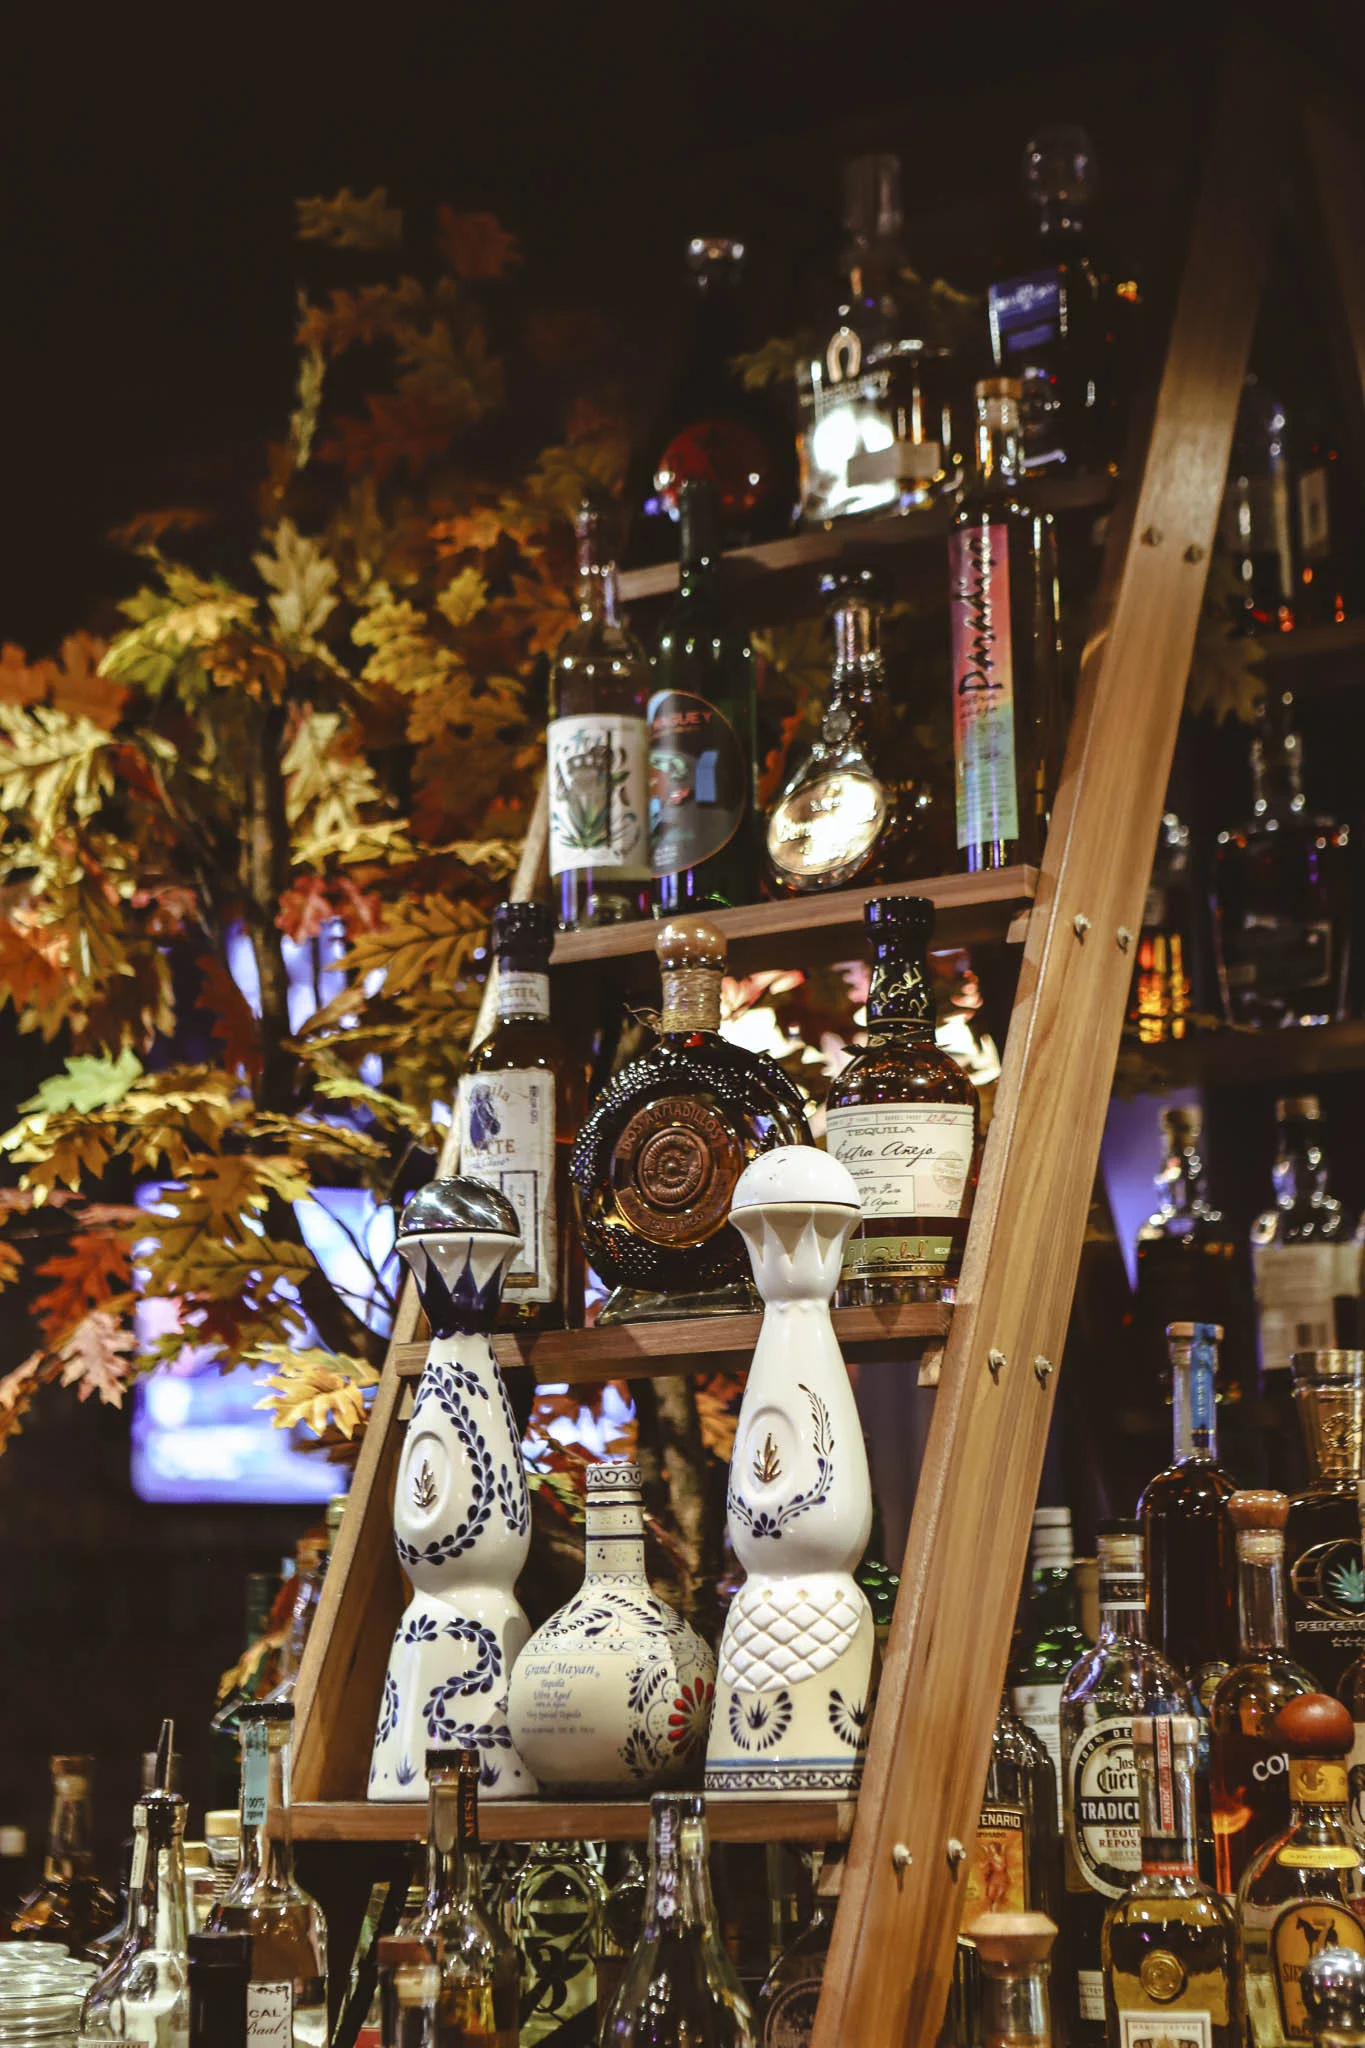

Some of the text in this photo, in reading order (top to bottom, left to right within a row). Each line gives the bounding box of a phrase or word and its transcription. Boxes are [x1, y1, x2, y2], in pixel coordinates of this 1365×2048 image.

[644, 1103, 727, 1141] ARMADILLOS
[845, 1126, 915, 1137] TEQUILA
[835, 1140, 936, 1168] Extra Añejo
[525, 1661, 594, 1679] Grand Mayan
[1078, 1736, 1104, 1766] 100%
